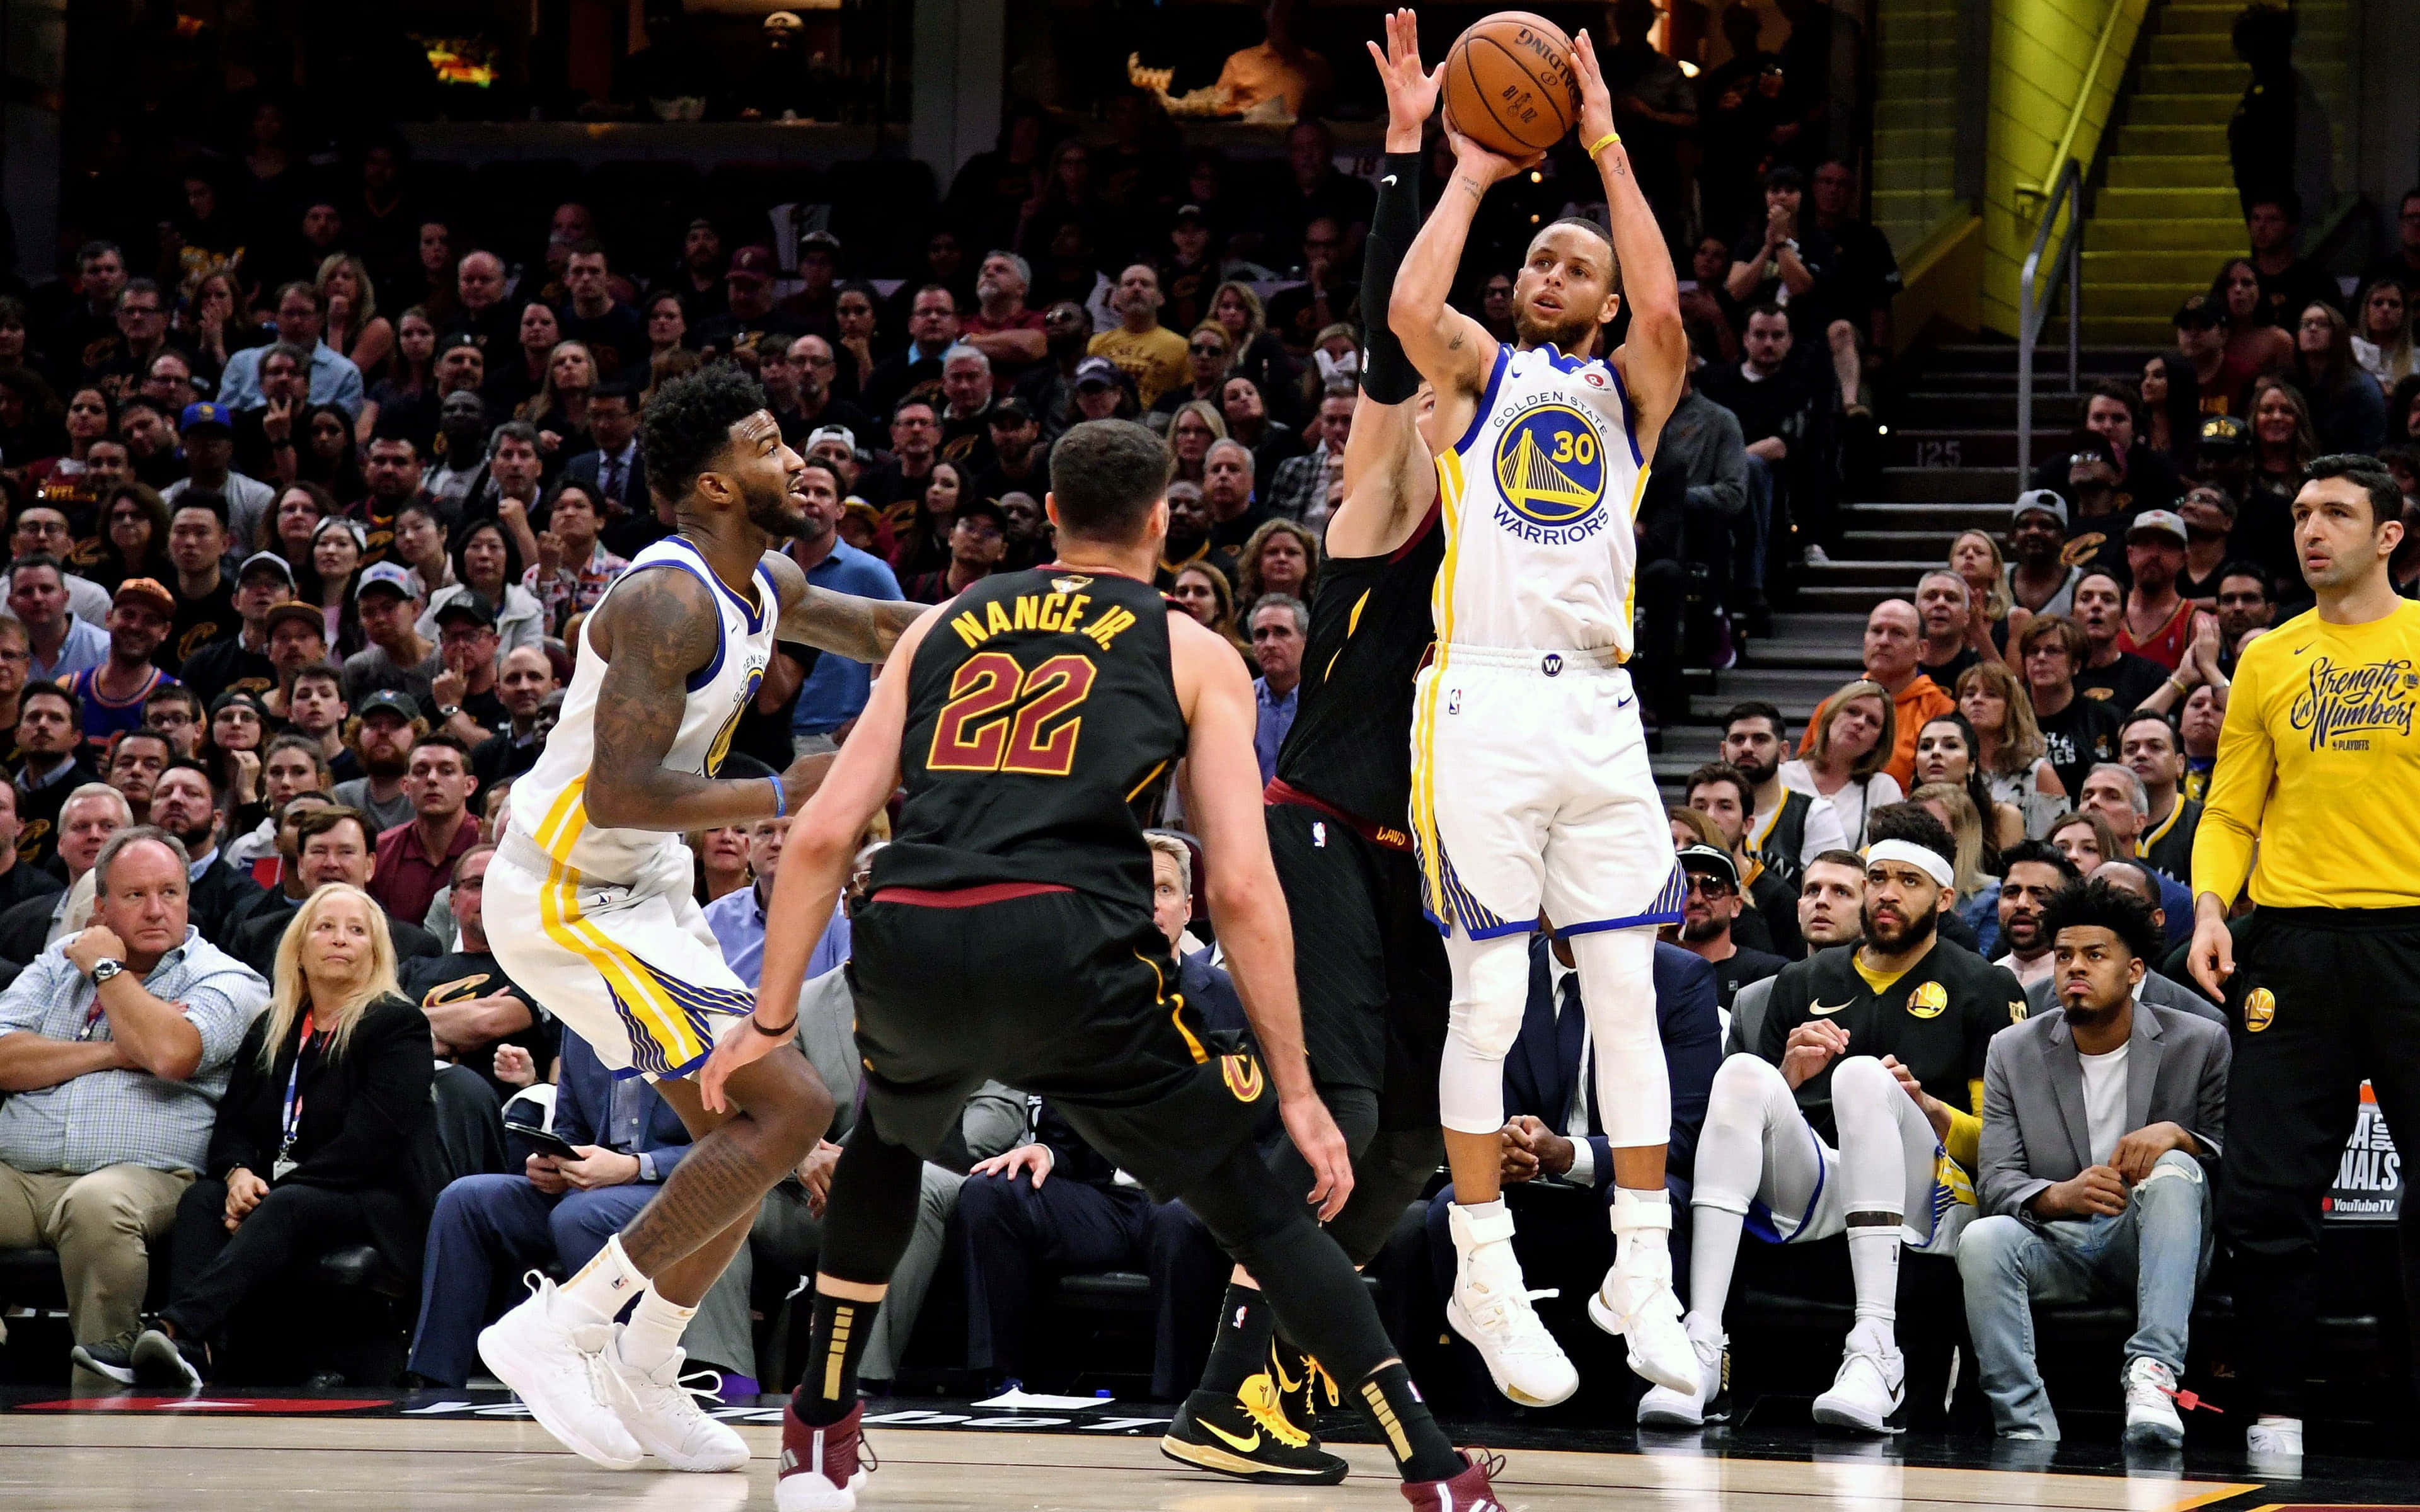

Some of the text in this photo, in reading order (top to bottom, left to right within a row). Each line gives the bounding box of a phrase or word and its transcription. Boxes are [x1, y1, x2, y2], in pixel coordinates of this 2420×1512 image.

[1494, 391, 1608, 437] GOLDEN STATE
[1551, 430, 1595, 466] 30
[1493, 502, 1609, 546] WARRIORS
[950, 592, 1136, 651] NANCE JR.
[926, 651, 1098, 776] 22
[2338, 740, 2370, 751] PLAYOFFS
